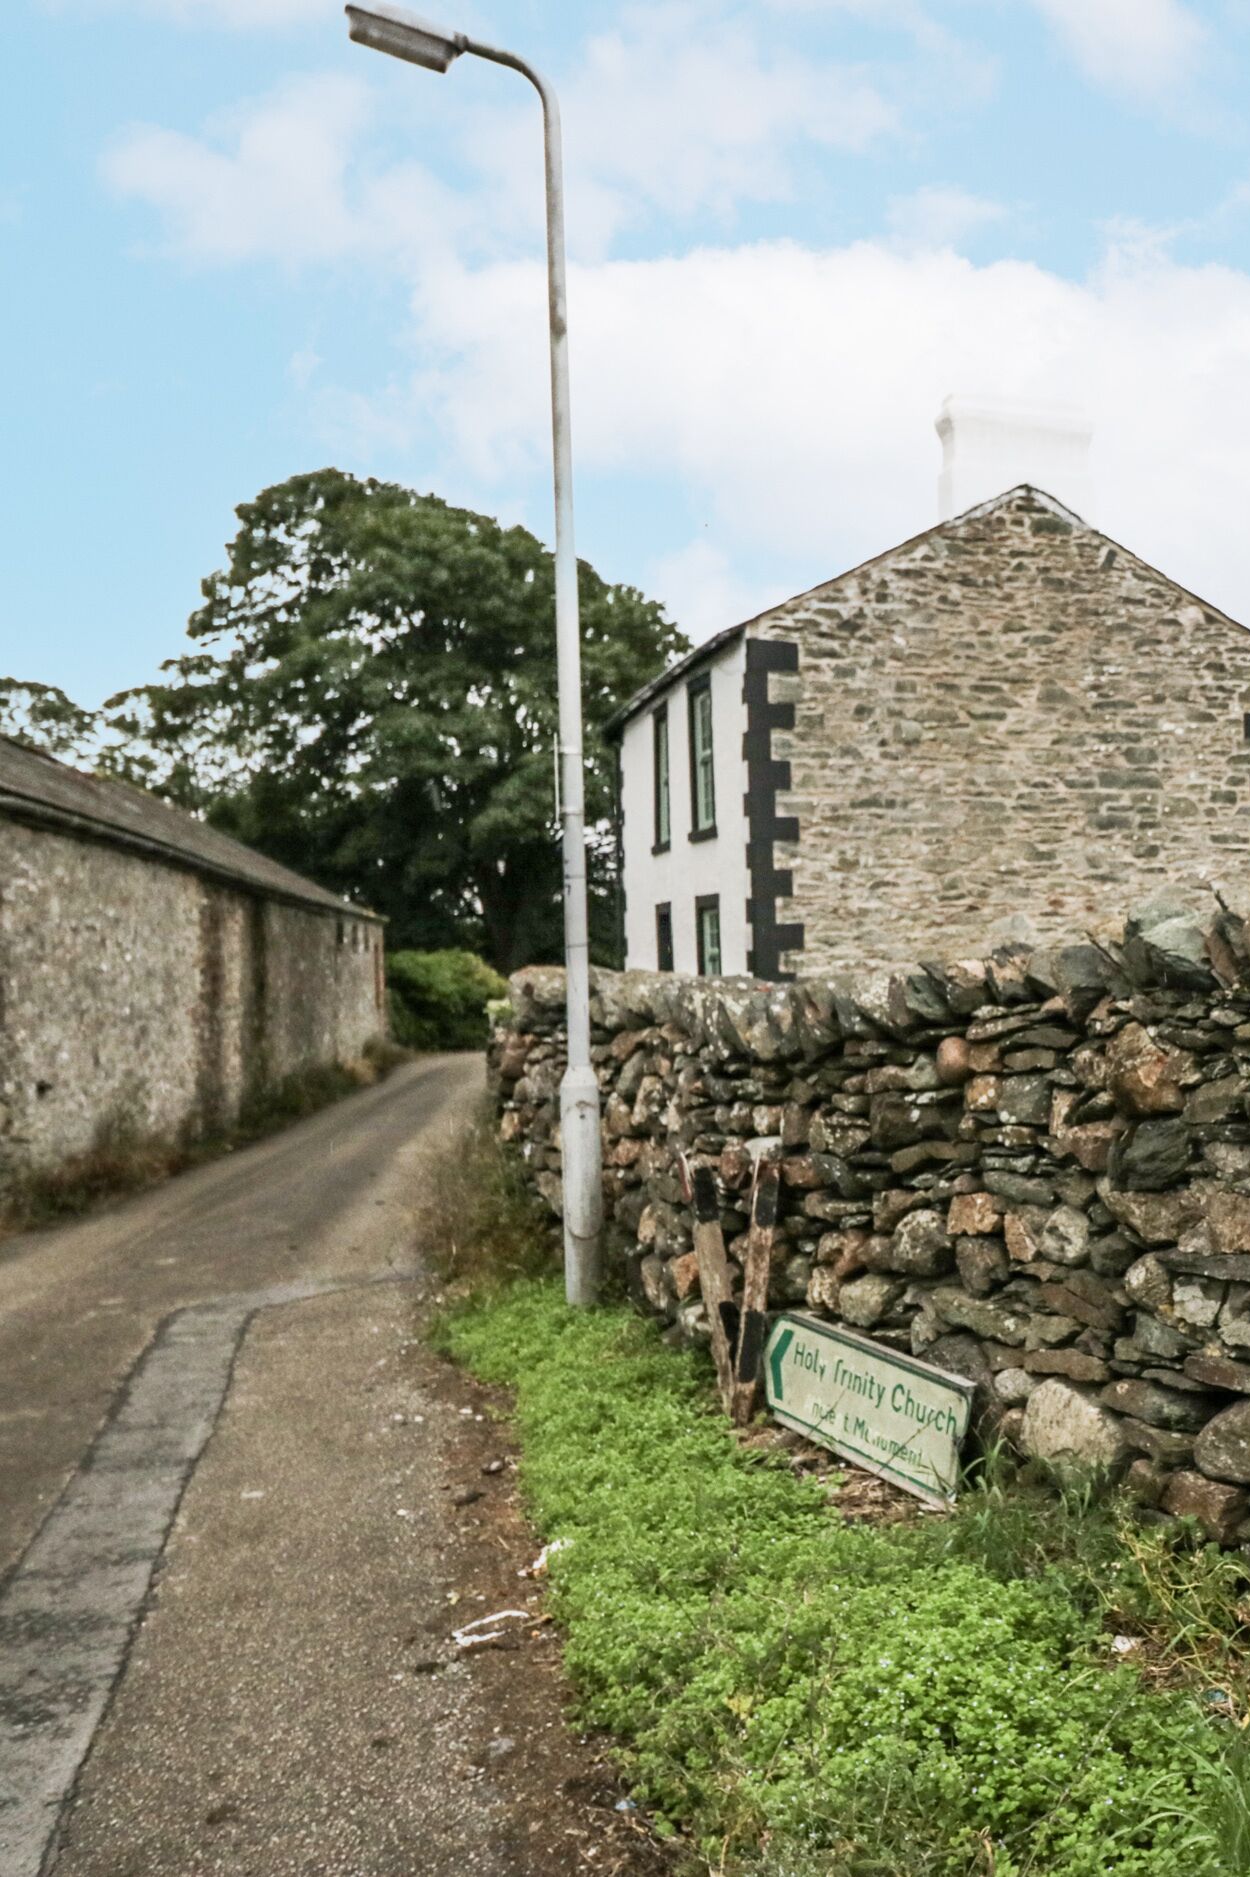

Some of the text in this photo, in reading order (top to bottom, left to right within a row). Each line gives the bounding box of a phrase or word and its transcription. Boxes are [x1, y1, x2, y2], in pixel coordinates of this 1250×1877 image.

[793, 1342, 958, 1437] Holy Trinity Church
